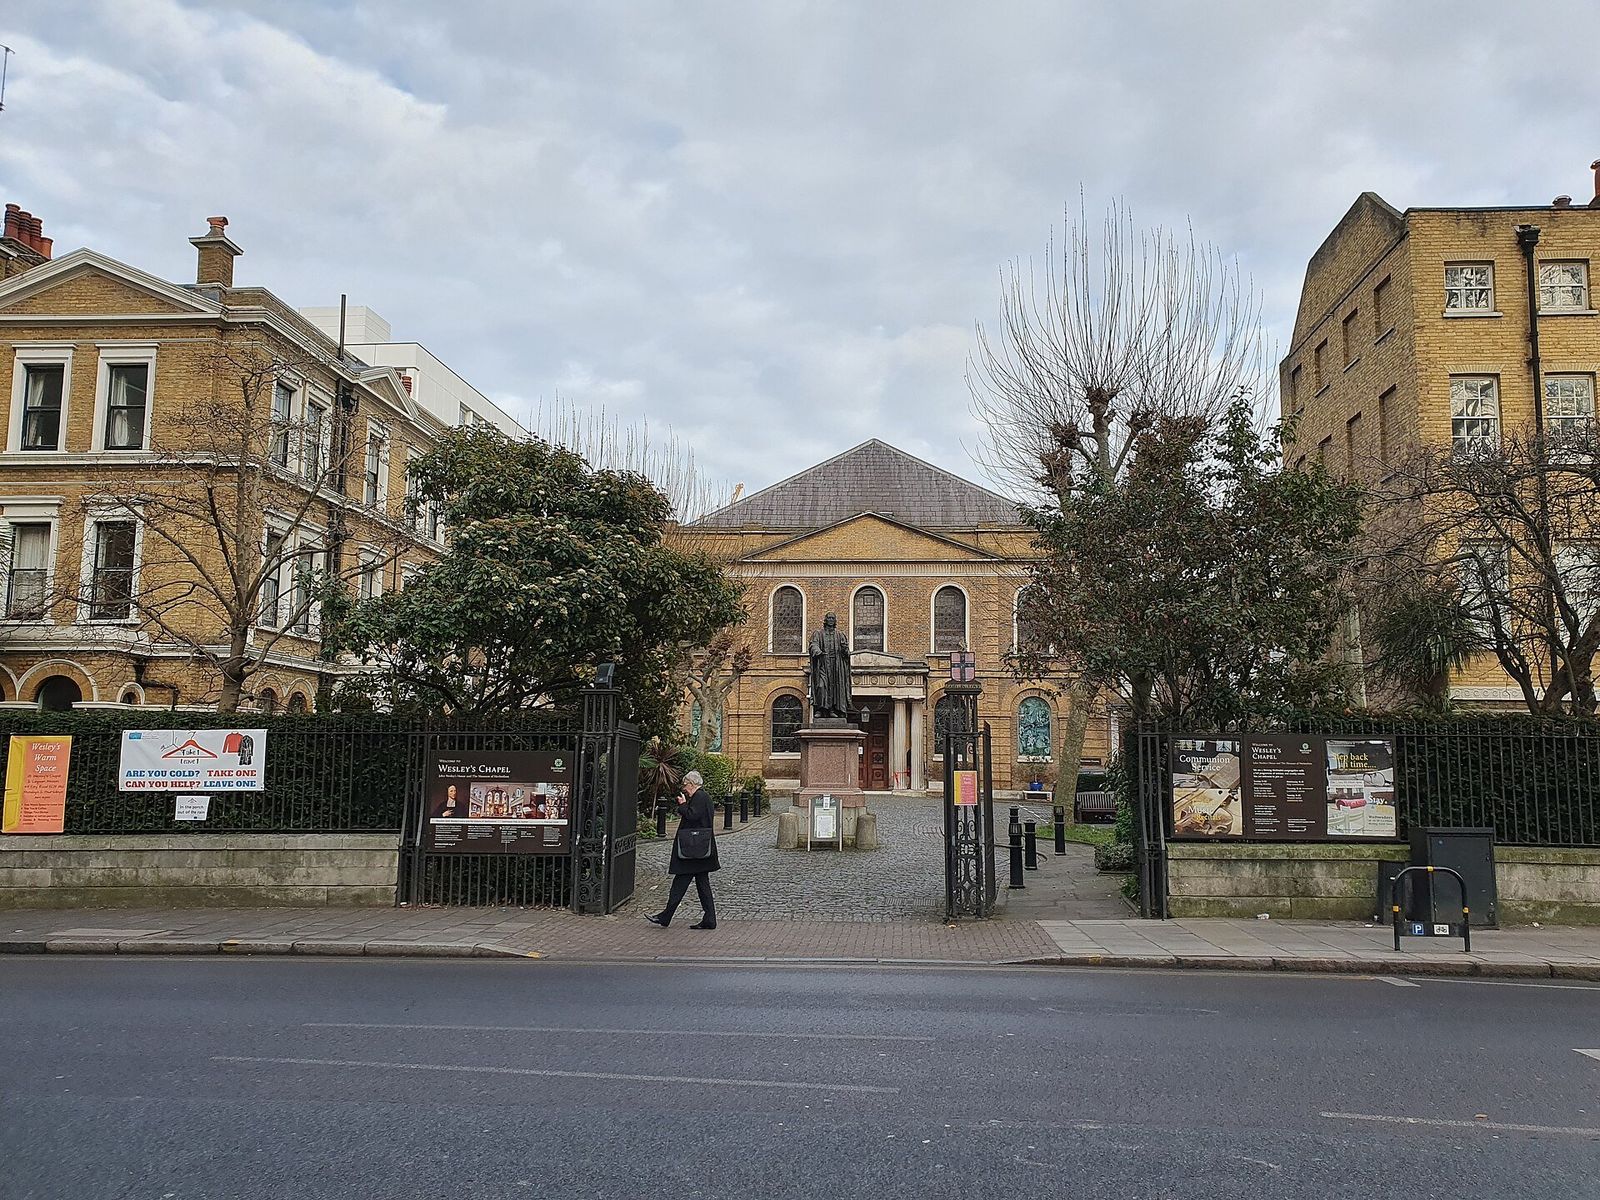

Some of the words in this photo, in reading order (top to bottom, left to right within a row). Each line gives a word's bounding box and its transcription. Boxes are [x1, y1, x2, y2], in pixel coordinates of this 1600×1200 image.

[32, 743, 61, 752] Wesley's
[1179, 754, 1230, 764] Communion
[1350, 753, 1369, 761] back
[35, 765, 57, 773] Space
[438, 764, 477, 773] WESLEY'S
[478, 764, 511, 773] CHAPEL
[1191, 763, 1221, 771] Service
[126, 770, 146, 778] ARE
[147, 770, 168, 778] YOU
[169, 770, 200, 778] COLD?
[170, 780, 201, 788] HELP?
[203, 780, 234, 788] LEAVE
[235, 780, 257, 788] ONE
[1415, 925, 1422, 934] P
